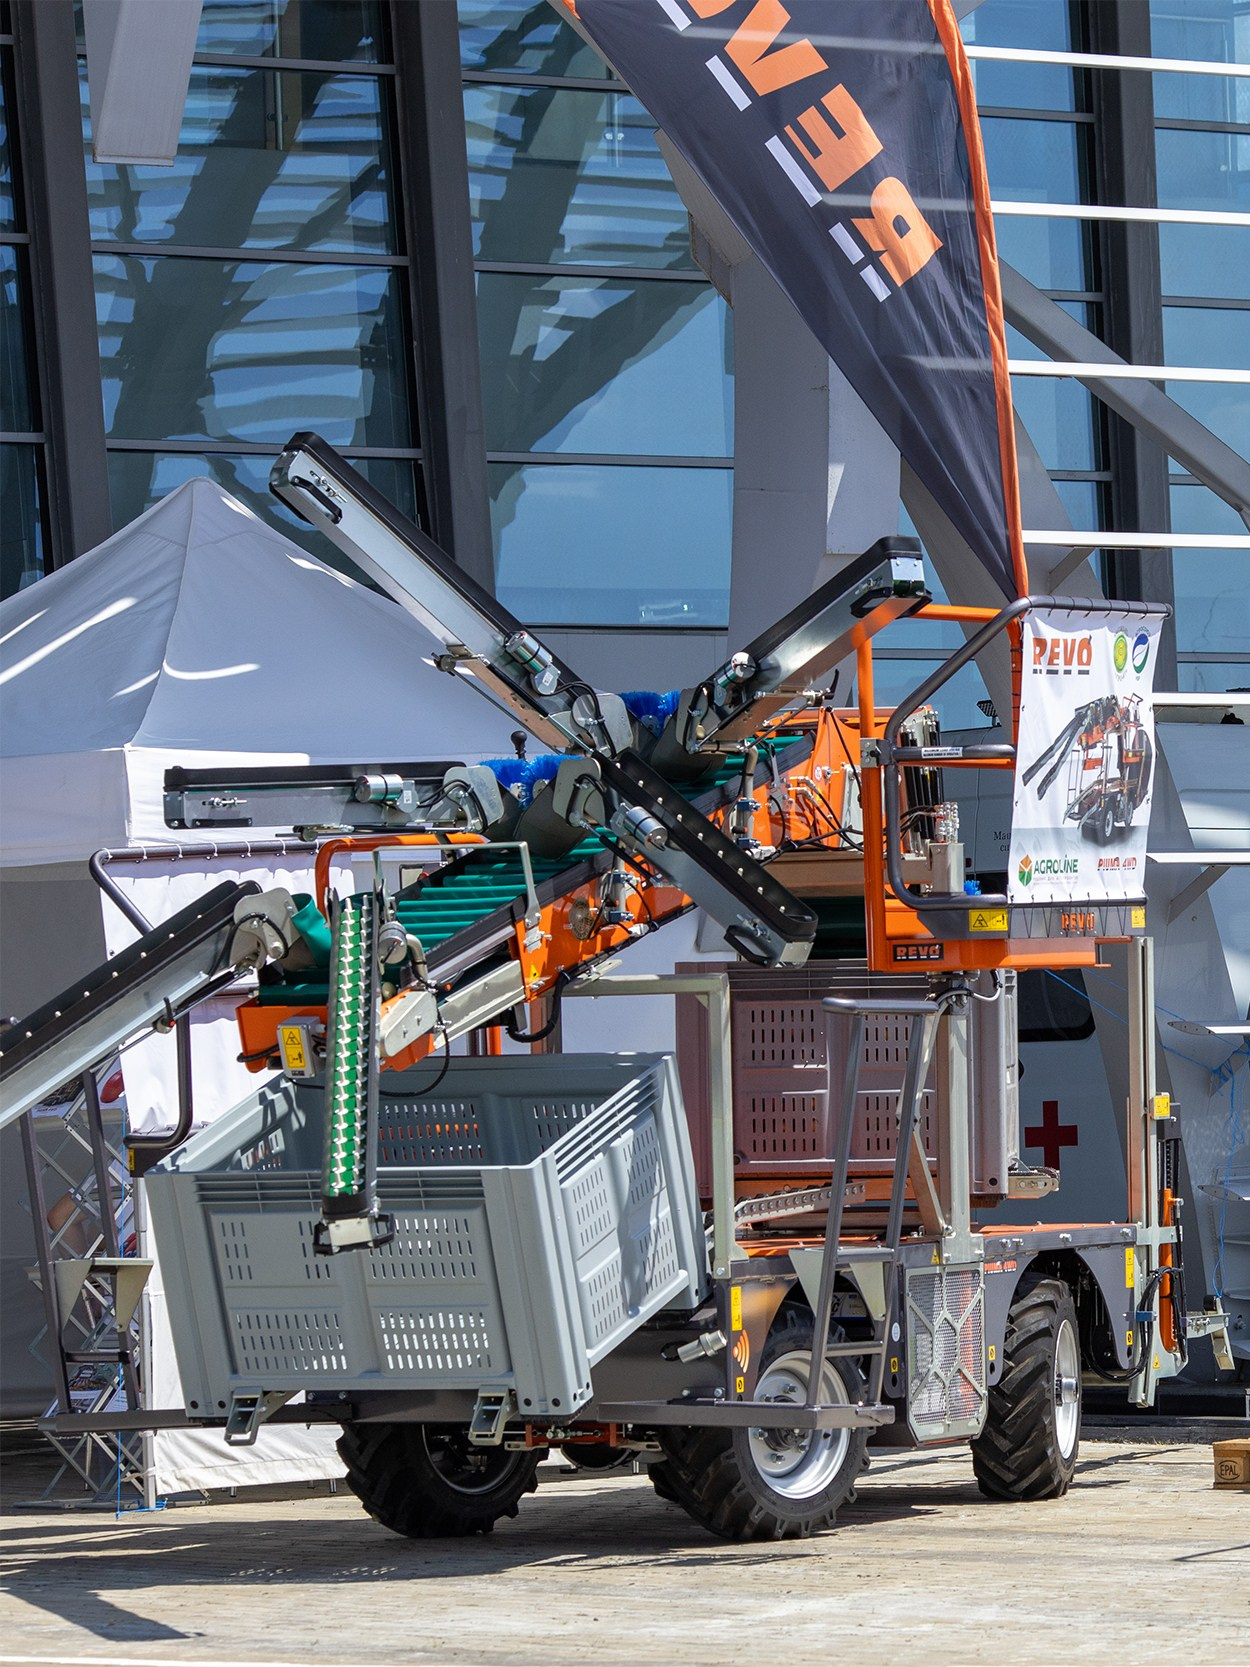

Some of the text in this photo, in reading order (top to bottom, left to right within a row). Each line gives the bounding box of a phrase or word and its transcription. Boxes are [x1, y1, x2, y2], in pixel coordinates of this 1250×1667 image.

[1032, 636, 1093, 666] REVO
[1033, 856, 1079, 875] AGROLINE
[1061, 912, 1096, 932] REVO
[896, 945, 941, 958] REVO
[1219, 1464, 1239, 1476] EPAL
